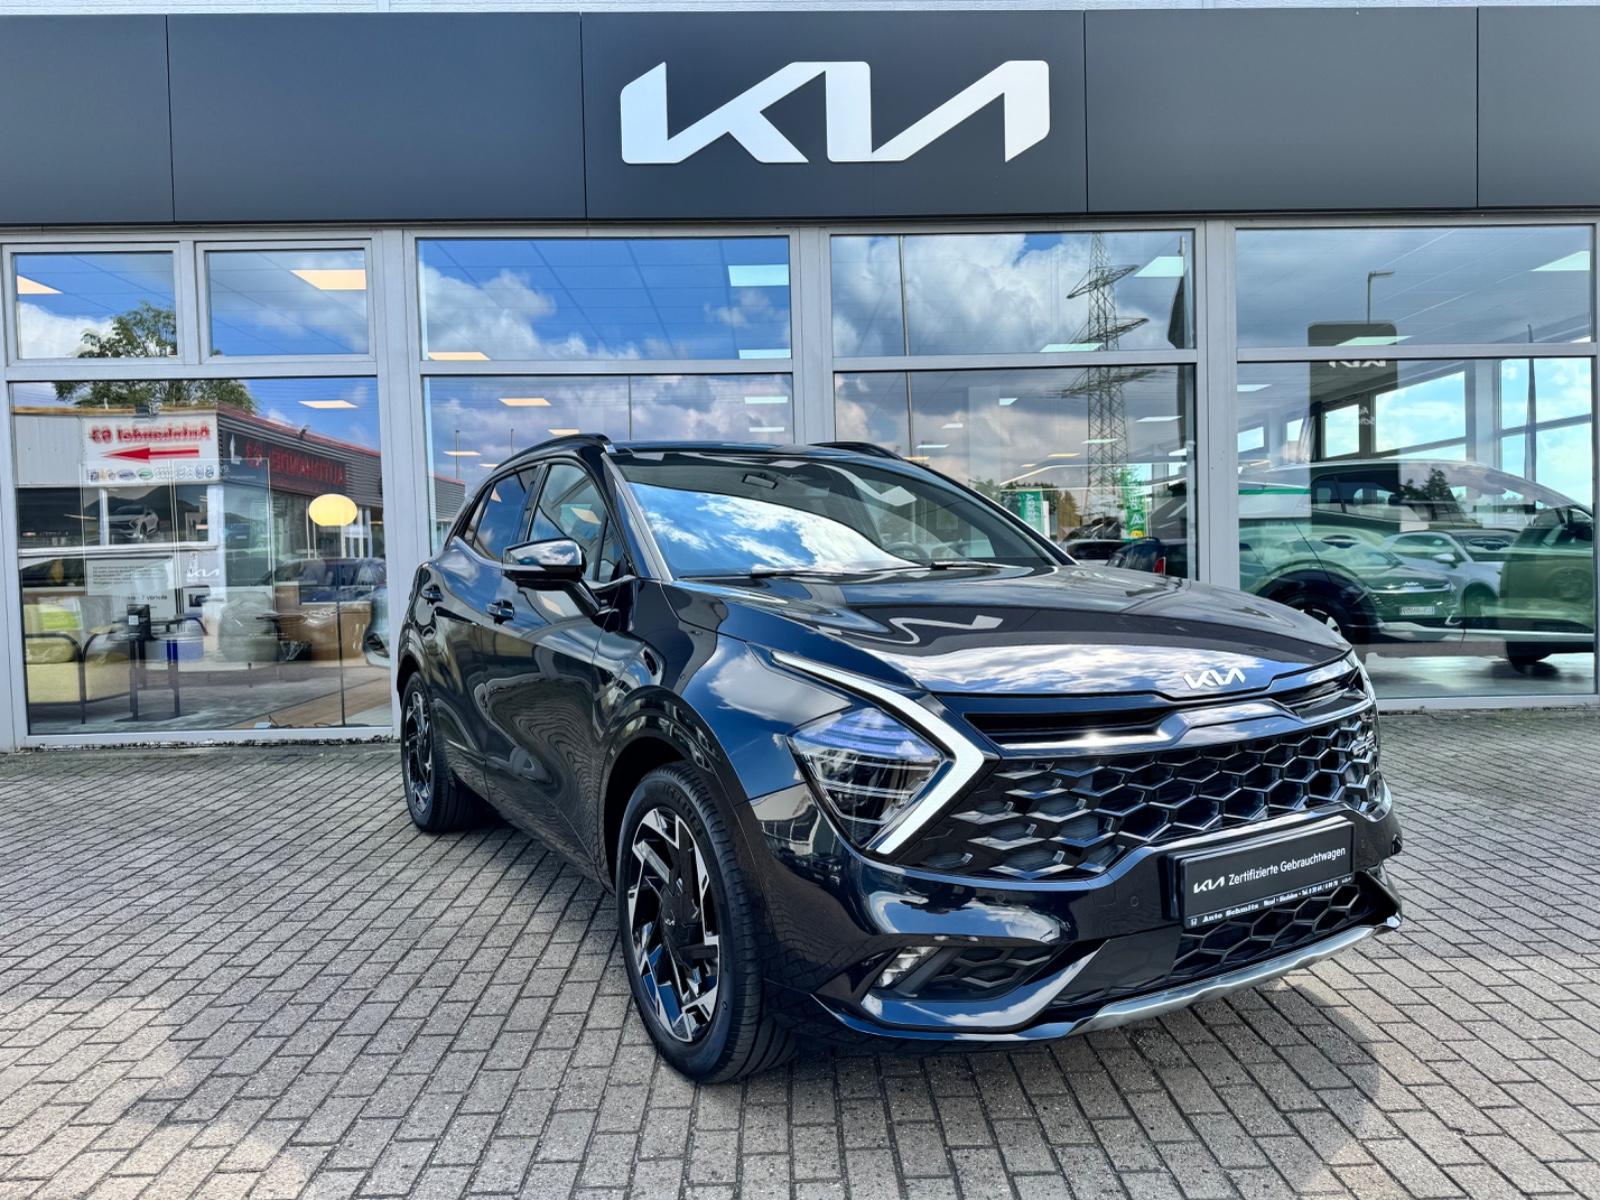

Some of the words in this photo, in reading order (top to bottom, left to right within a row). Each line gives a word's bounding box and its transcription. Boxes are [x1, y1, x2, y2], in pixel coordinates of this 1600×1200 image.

[620, 60, 1050, 164] KIA
[1183, 667, 1246, 690] KIA
[1193, 876, 1225, 894] KIA
[1228, 864, 1279, 886] Zertifizierte
[1280, 847, 1346, 872] Gebrauchtwagen
[1202, 912, 1224, 923] Auto
